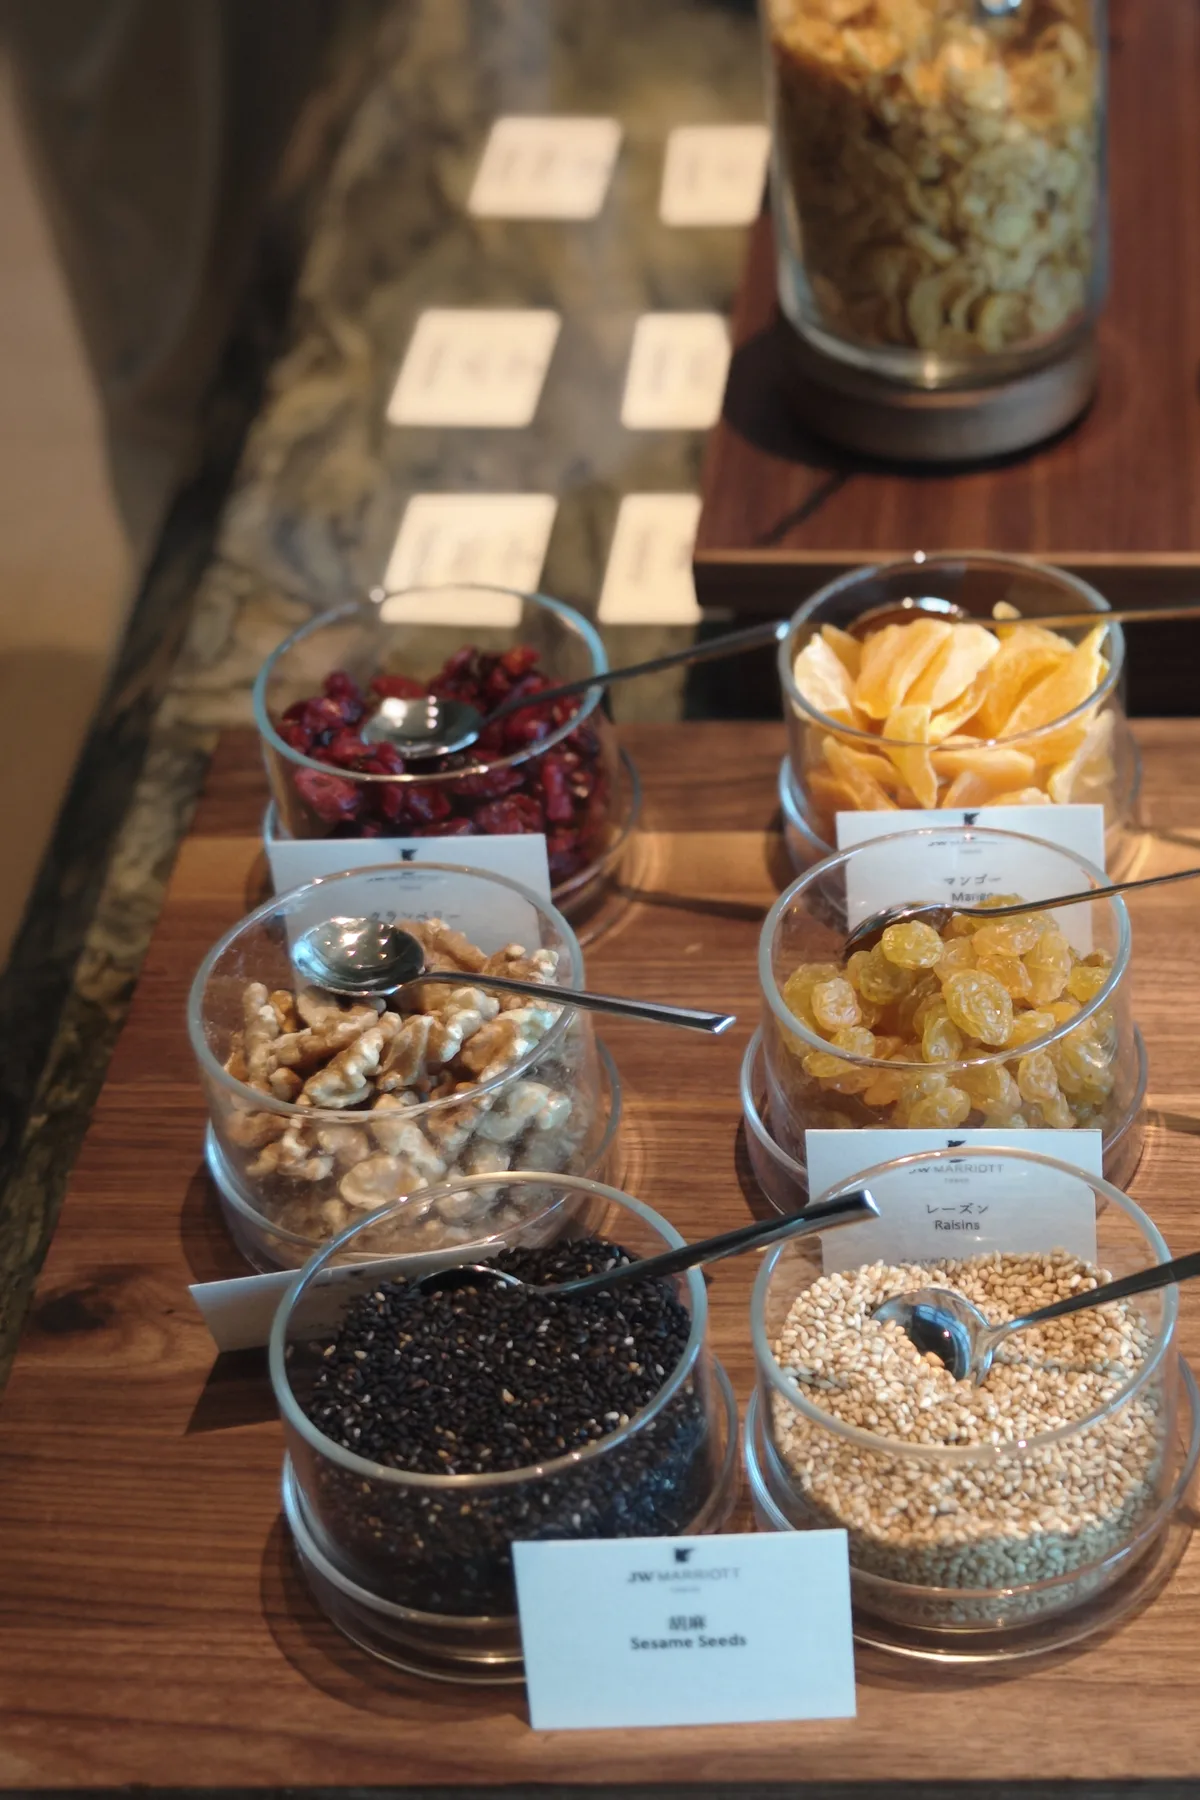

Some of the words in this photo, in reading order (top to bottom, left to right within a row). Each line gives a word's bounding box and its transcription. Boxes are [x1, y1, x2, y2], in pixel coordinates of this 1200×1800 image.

[943, 873, 1002, 887] マンゴー
[934, 1163, 1005, 1174] MARRIOTT
[926, 1202, 989, 1214] レーズン
[934, 1219, 981, 1231] Raisins
[628, 1571, 652, 1583] JW
[657, 1567, 741, 1581] MARRIOTT
[630, 1636, 693, 1651] Sesame
[698, 1633, 747, 1648] Seeds
